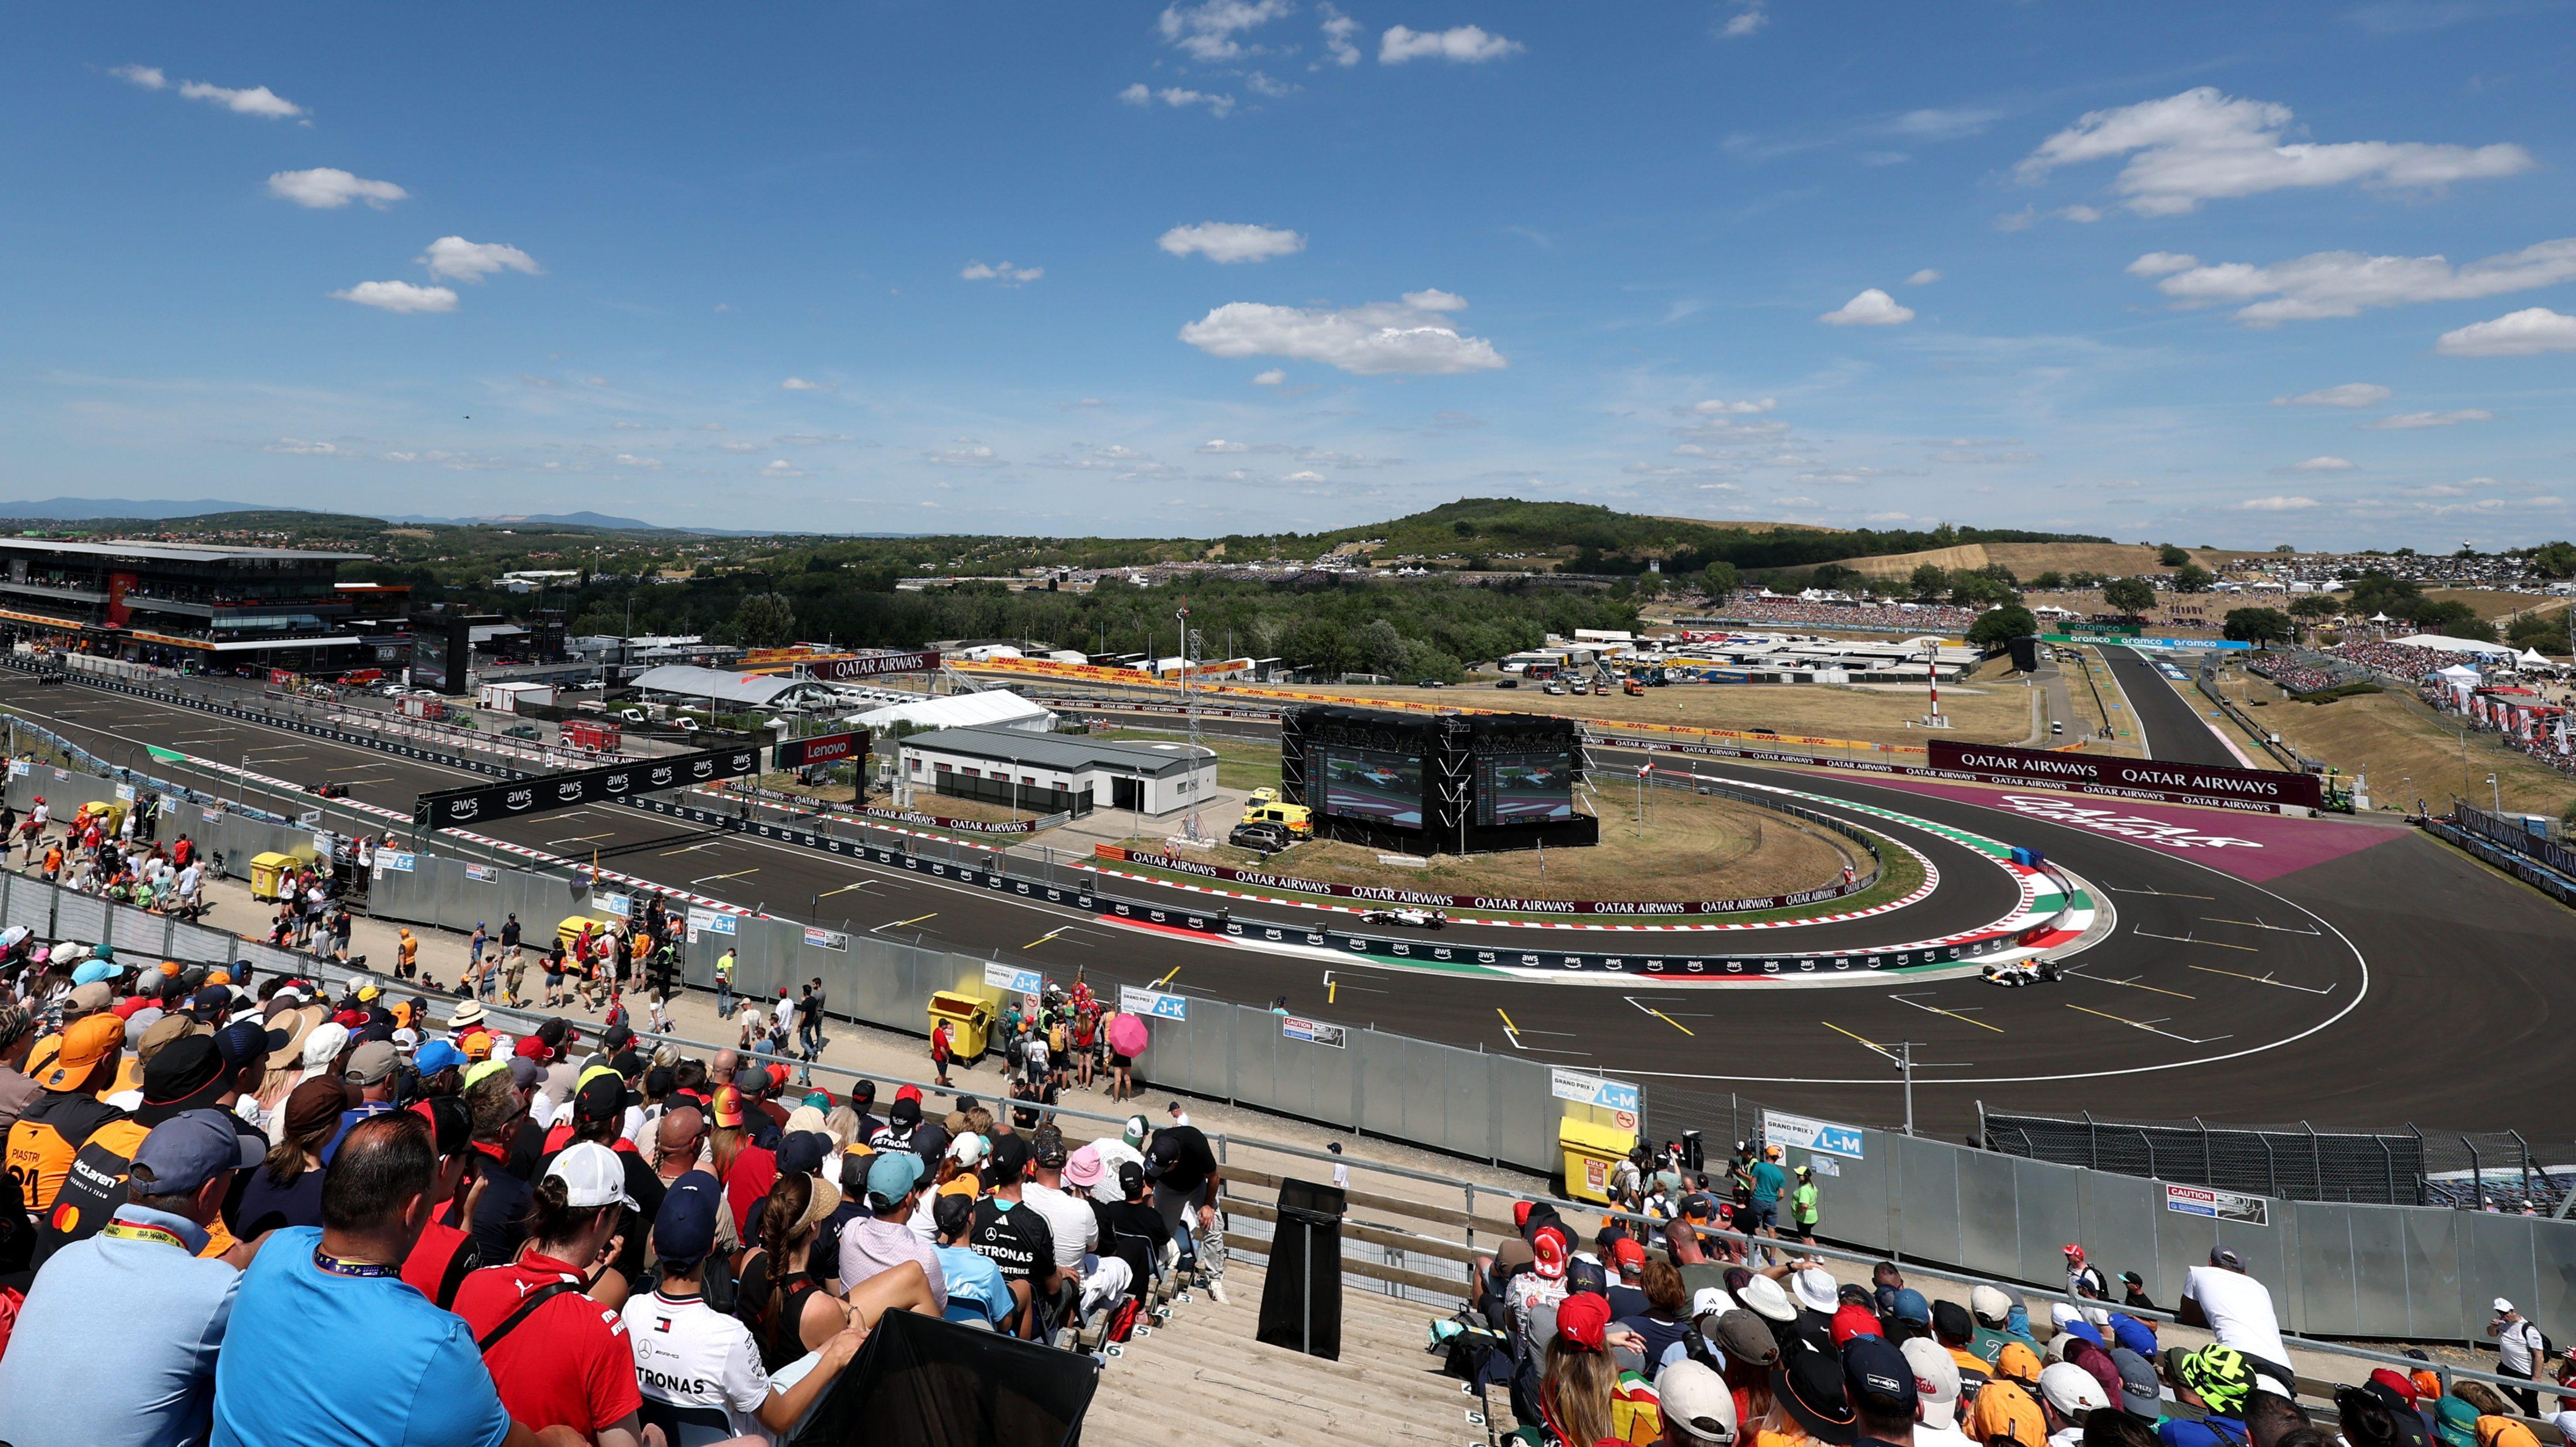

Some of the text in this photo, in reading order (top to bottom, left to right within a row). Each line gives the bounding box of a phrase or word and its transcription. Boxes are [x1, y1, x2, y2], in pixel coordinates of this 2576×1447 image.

[2075, 623, 2120, 632] aramco
[378, 649, 395, 659] FIA
[836, 656, 923, 677] QATAR AIRWAYS
[1203, 665, 1217, 674] DHL
[1226, 663, 1242, 671] DHL
[808, 742, 847, 759] Lenovo
[1709, 749, 1741, 757] AIRWAYS
[596, 754, 617, 764] QATAR
[694, 760, 713, 771] aws
[733, 754, 750, 765] aws
[1781, 756, 1814, 764] AIRWAYS
[1961, 754, 2098, 777] QATAR AIRWAYS
[1826, 760, 1893, 772] QATAR AIRWAYS
[607, 773, 628, 786] aws
[652, 767, 672, 779] aws
[1906, 768, 1976, 781] QATAR AIRWAYS
[559, 781, 582, 794] aws
[1991, 776, 2067, 790] QATAR AIRWAYS
[2122, 769, 2278, 795] QATAR AIRWAYS
[508, 789, 531, 802] aws
[2084, 786, 2165, 801] QATAR AIRWAYS
[452, 798, 478, 811] aws
[2182, 797, 2270, 812] QATAR AIRWAYS
[867, 807, 936, 825] QATAR AIRWAYS
[950, 819, 1027, 832] QATAR AIRWAYS
[398, 858, 413, 868] E-F
[1133, 851, 1216, 877] QATAR AIRWAYS
[1236, 871, 1331, 893] QATAR AIRWAYS
[1352, 887, 1453, 906] QATAR AIRWAYS
[1786, 888, 1837, 905] QATAR AIRWAYS
[612, 900, 627, 913] G-H
[1475, 898, 1574, 913] QATAR AIRWAYS
[1595, 902, 1684, 914] QATAR AIRWAYS
[1701, 898, 1773, 912] QATAR AIRWAYS
[715, 919, 735, 932] G-H
[1350, 939, 1366, 947] aws
[1950, 948, 1960, 956] aws
[1522, 955, 1538, 963] aws
[1605, 959, 1622, 967] aws
[1836, 959, 1848, 967] aws
[1017, 977, 1039, 992] J-K
[1159, 1001, 1184, 1016] J-K
[1286, 1019, 1311, 1029] CAUTION
[1555, 1078, 1575, 1087] GRAND
[1602, 1089, 1635, 1109] L-M
[1768, 1121, 1791, 1131] GRAND
[1793, 1126, 1809, 1134] PRIX
[1822, 1132, 1860, 1153] L-M
[12, 1149, 40, 1162] PIASTRI
[1586, 1159, 1605, 1168] SULO
[73, 1158, 117, 1188] McLaren
[69, 1176, 87, 1191] FORMULA
[93, 1190, 108, 1199] TEAM
[2171, 1188, 2212, 1201] CAUTION
[972, 1243, 1034, 1262] PETRONAS
[999, 1265, 1029, 1274] DSTRIKE
[1180, 1294, 1190, 1303] 3
[1158, 1308, 1170, 1317] 4
[1135, 1325, 1149, 1336] 5
[1106, 1345, 1121, 1356] 6
[636, 1366, 705, 1394] TRONAS
[1469, 1412, 1484, 1423] 5
